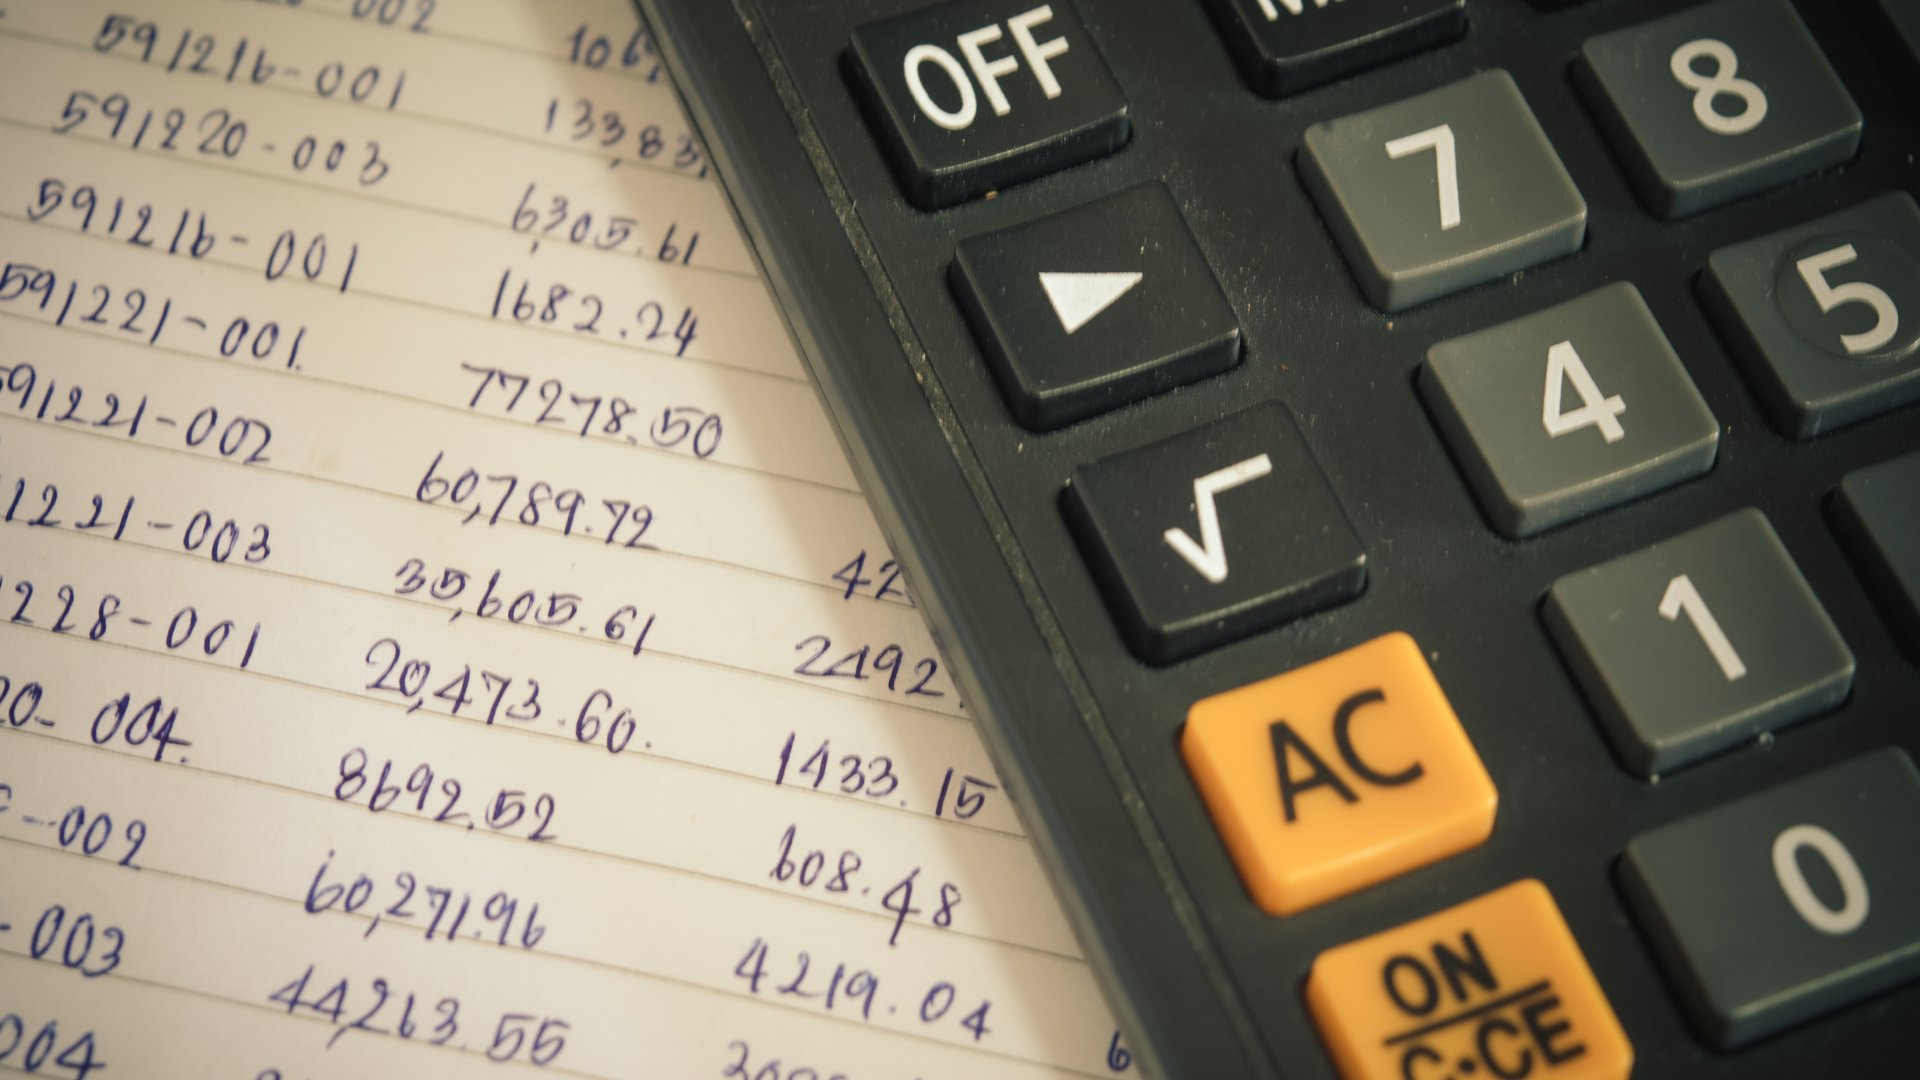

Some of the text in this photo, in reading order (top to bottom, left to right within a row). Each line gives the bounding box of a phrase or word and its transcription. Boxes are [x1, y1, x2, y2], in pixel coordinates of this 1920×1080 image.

[94, 14, 405, 110] 591216-001
[904, 4, 1069, 130] OFF
[1670, 38, 1768, 135] 8
[52, 91, 389, 185] 591220-003
[546, 98, 708, 180] 133,83
[1385, 124, 1461, 230] 7
[27, 179, 358, 293] 591216-001
[491, 268, 699, 357] 1682.24
[1796, 244, 1899, 354] 5
[461, 362, 722, 459] 77278.50
[1542, 340, 1626, 443] 4
[416, 451, 660, 550] 60,789.72
[0, 574, 260, 668] 228-001
[395, 558, 655, 655] 35,605.61
[1658, 574, 1747, 681] 1
[335, 747, 557, 840] 8692.52
[775, 731, 997, 818] 1433.15
[1268, 688, 1424, 823] AC
[304, 849, 546, 948] 60,271.96
[770, 824, 961, 945] 608.48
[1772, 824, 1869, 935] 0
[735, 937, 992, 1041] 4219.04
[1382, 930, 1499, 1017] ON
